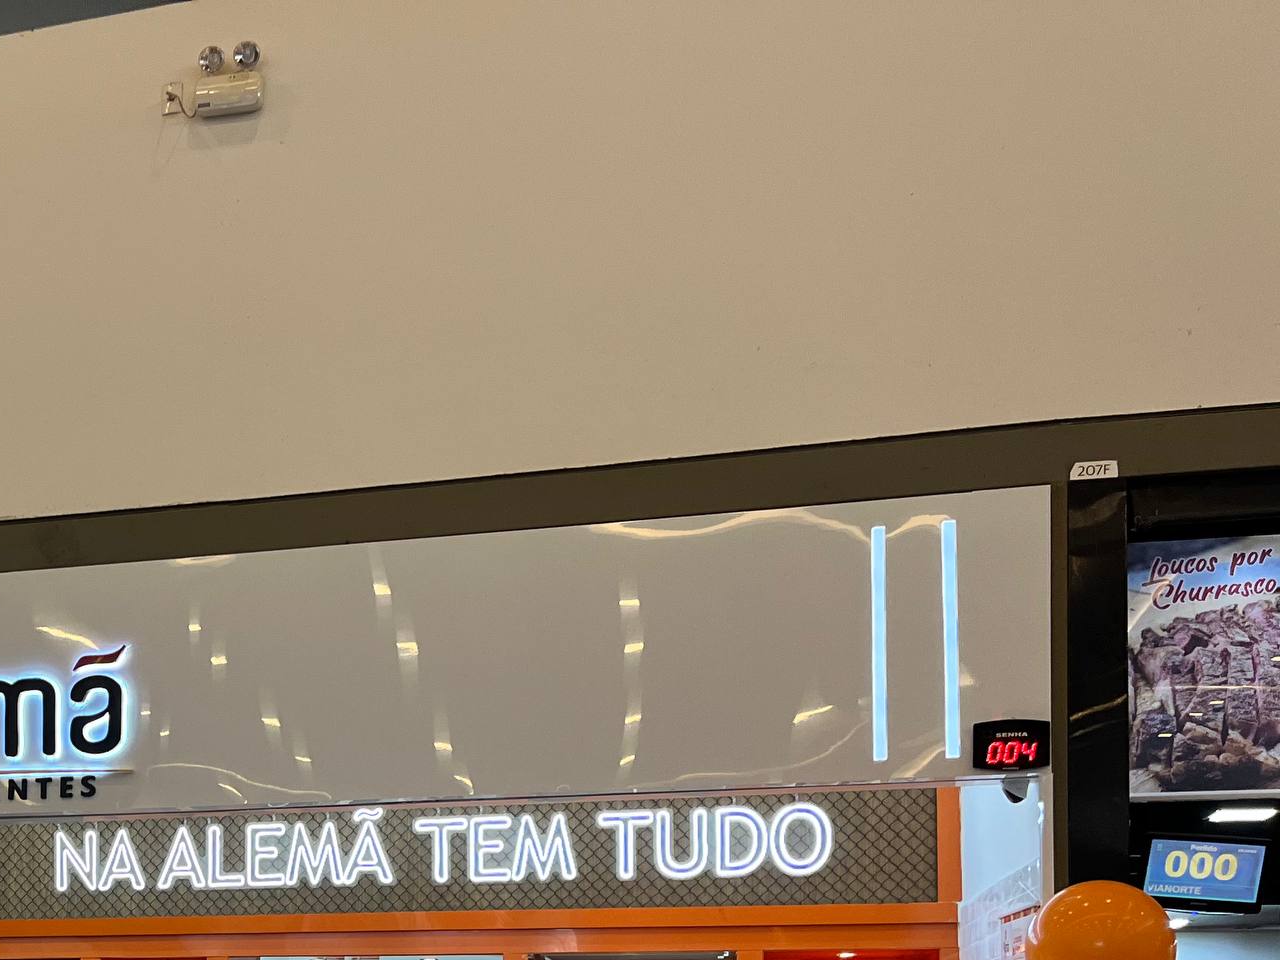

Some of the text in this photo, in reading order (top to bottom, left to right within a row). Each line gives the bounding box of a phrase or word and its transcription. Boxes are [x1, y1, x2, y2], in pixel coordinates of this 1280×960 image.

[1077, 464, 1111, 477] 207F
[1142, 548, 1273, 586] Loucos por
[1152, 578, 1277, 610] Churrasco
[986, 741, 1039, 764] 004
[54, 802, 837, 894] NA ALEMÃ TEM TUDO
[1164, 850, 1238, 881] 000
[1147, 883, 1202, 895] VIANORTE
